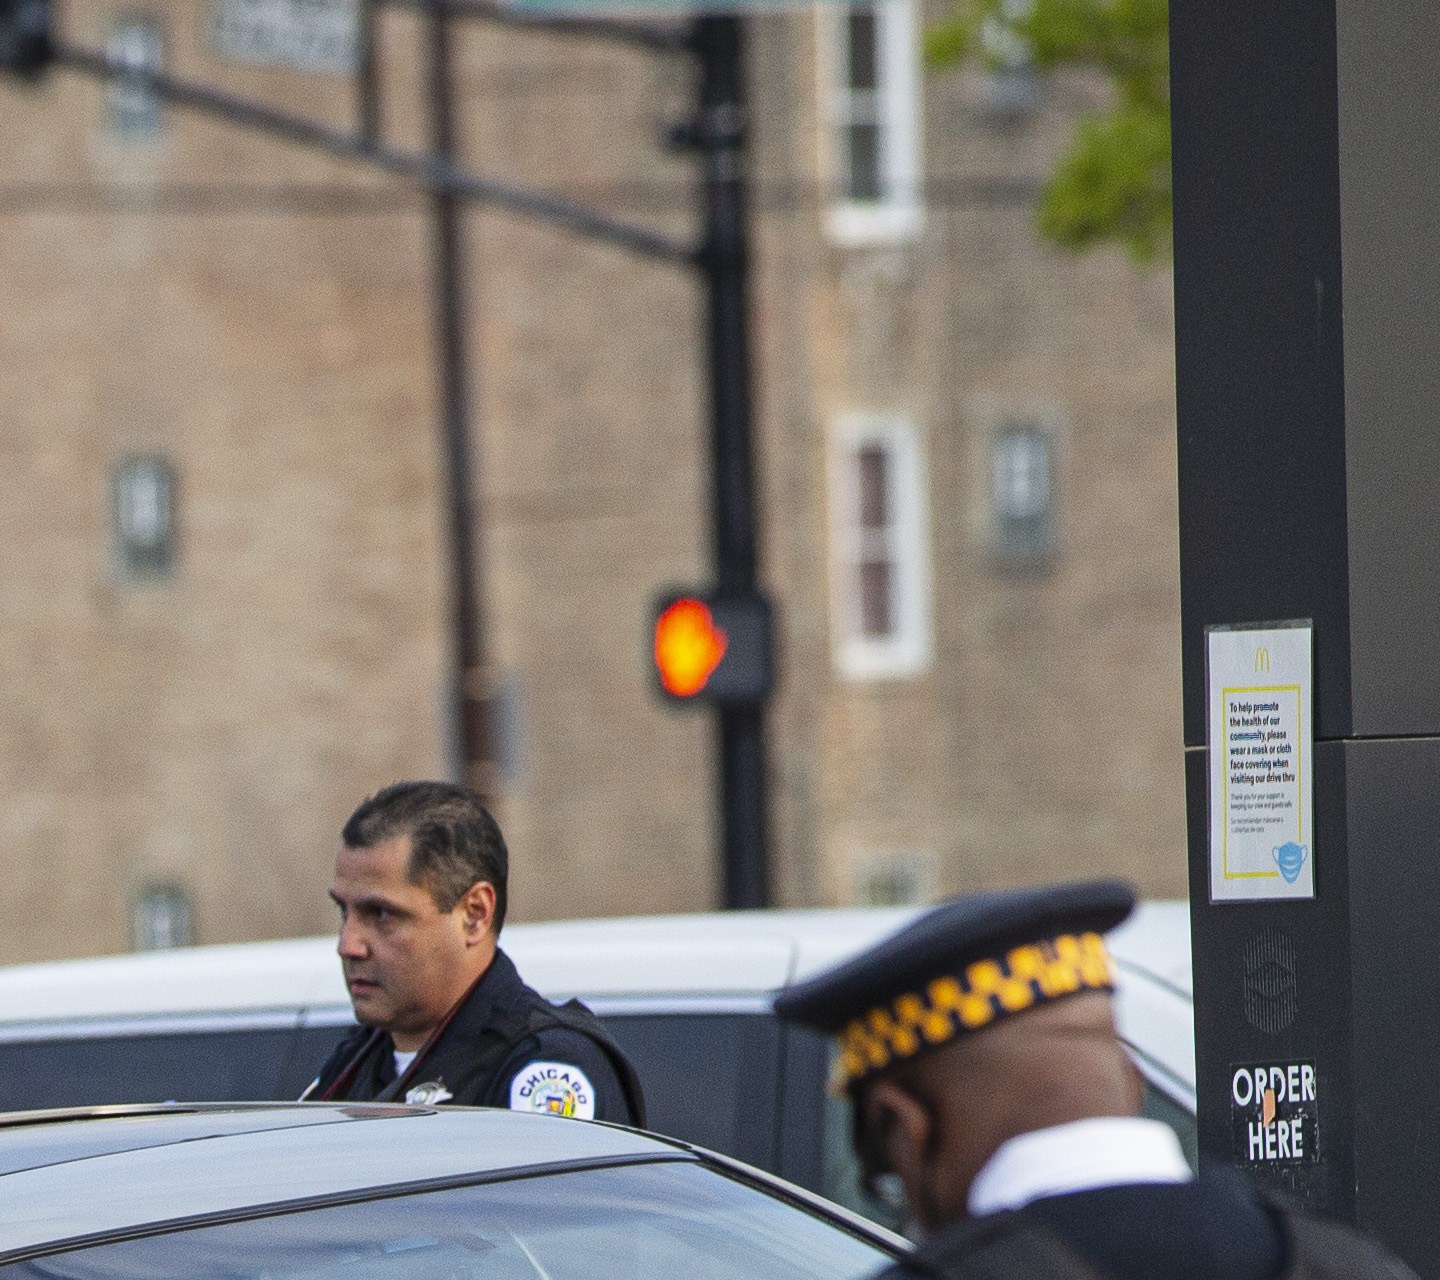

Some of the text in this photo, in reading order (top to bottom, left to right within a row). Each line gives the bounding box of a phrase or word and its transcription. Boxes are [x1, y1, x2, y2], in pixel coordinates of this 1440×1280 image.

[1230, 701, 1279, 714] To help promote
[1230, 714, 1280, 726] the health of our
[1267, 729, 1287, 742] please
[1230, 746, 1246, 755] wear
[1252, 744, 1268, 755] mask
[1269, 746, 1275, 754] or
[1277, 742, 1291, 754] cloth
[1231, 757, 1289, 771] face covering when
[1230, 772, 1254, 786] visiting
[1267, 771, 1281, 783] drive
[520, 1068, 587, 1105] CHICAGO
[1232, 1064, 1315, 1106] ORDER
[1248, 1118, 1304, 1160] HERE
